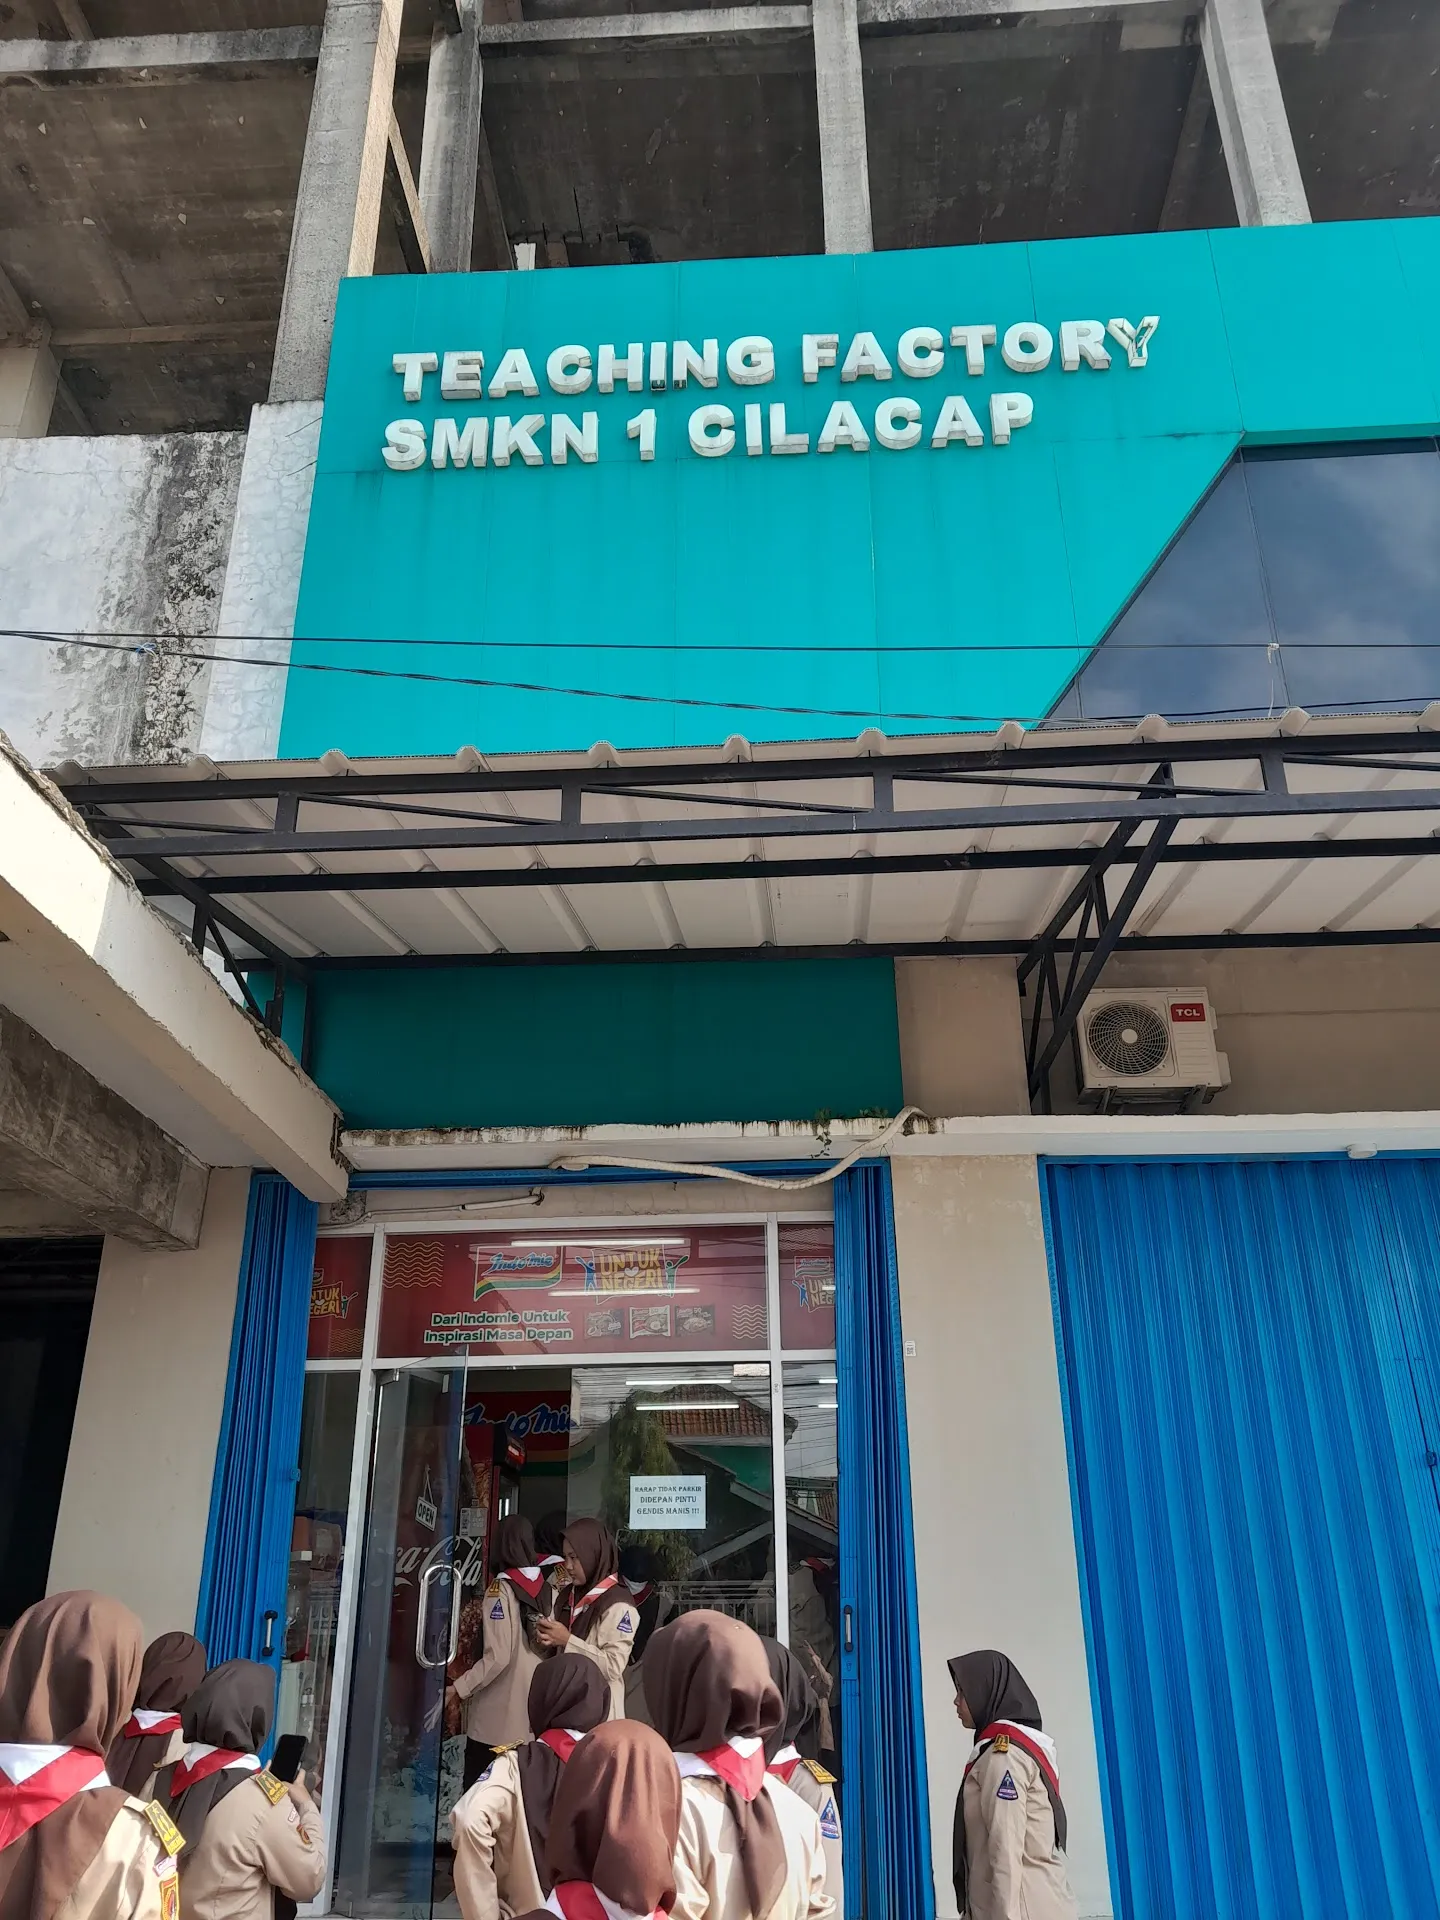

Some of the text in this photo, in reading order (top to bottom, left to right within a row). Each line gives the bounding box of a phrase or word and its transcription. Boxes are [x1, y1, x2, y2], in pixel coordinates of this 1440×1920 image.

[392, 315, 1161, 402] TEACHING FACTORY
[382, 391, 1034, 471] SMKN 1 CILACAP
[1175, 1008, 1200, 1017] TCL
[600, 1248, 661, 1275] UNTUK
[601, 1269, 663, 1291] NEGERI
[432, 1309, 567, 1325] Dari Indomie Untuk
[425, 1328, 572, 1344] Inspirasi Masa Depan
[675, 1495, 697, 1503] PINTU
[418, 1503, 435, 1527] OPEN
[636, 1507, 664, 1515] GENDIS
[665, 1507, 690, 1515] MANIS
